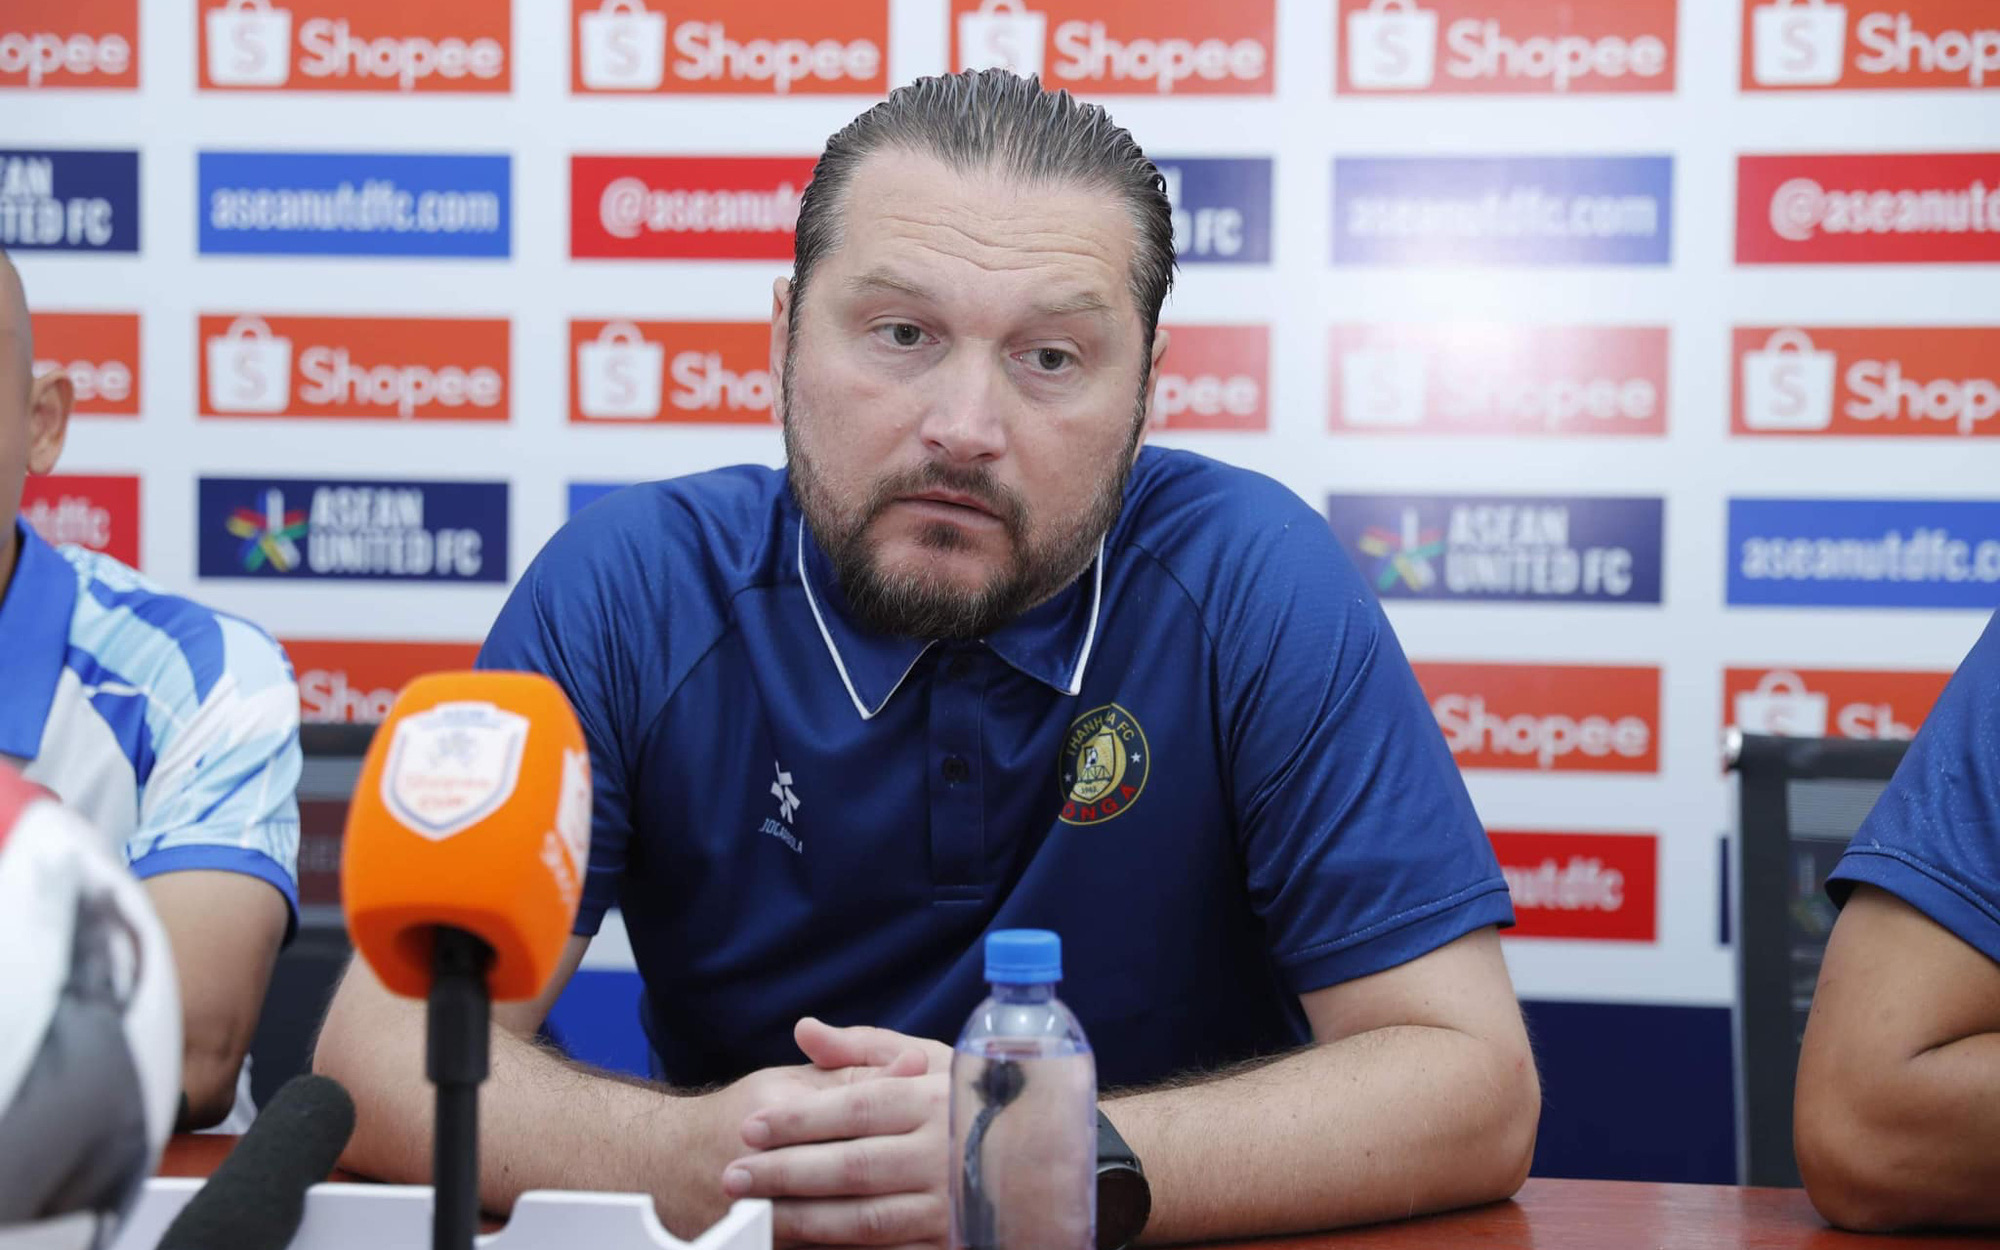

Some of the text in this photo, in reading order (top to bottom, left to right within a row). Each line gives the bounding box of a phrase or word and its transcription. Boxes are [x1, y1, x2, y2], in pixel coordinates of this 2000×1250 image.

[299, 17, 503, 90] Shopee
[672, 20, 880, 94] Shopee
[1053, 19, 1266, 93] Shopee
[1445, 18, 1666, 92] Shopee
[66, 196, 114, 246] FC
[210, 177, 499, 232] aseanutdfc.com
[600, 176, 802, 239] @aseanut
[1194, 206, 1243, 256] FC
[298, 345, 502, 419] Shopee
[1843, 358, 2000, 437] Shop
[308, 486, 424, 528] ASEAN
[1449, 504, 1569, 546] ASEAN
[308, 528, 483, 576] UNITED FC
[1445, 547, 1633, 596] UNITED FC
[1117, 721, 1135, 742] FC
[1433, 693, 1650, 770] Shopee
[1836, 702, 1914, 739] Sh
